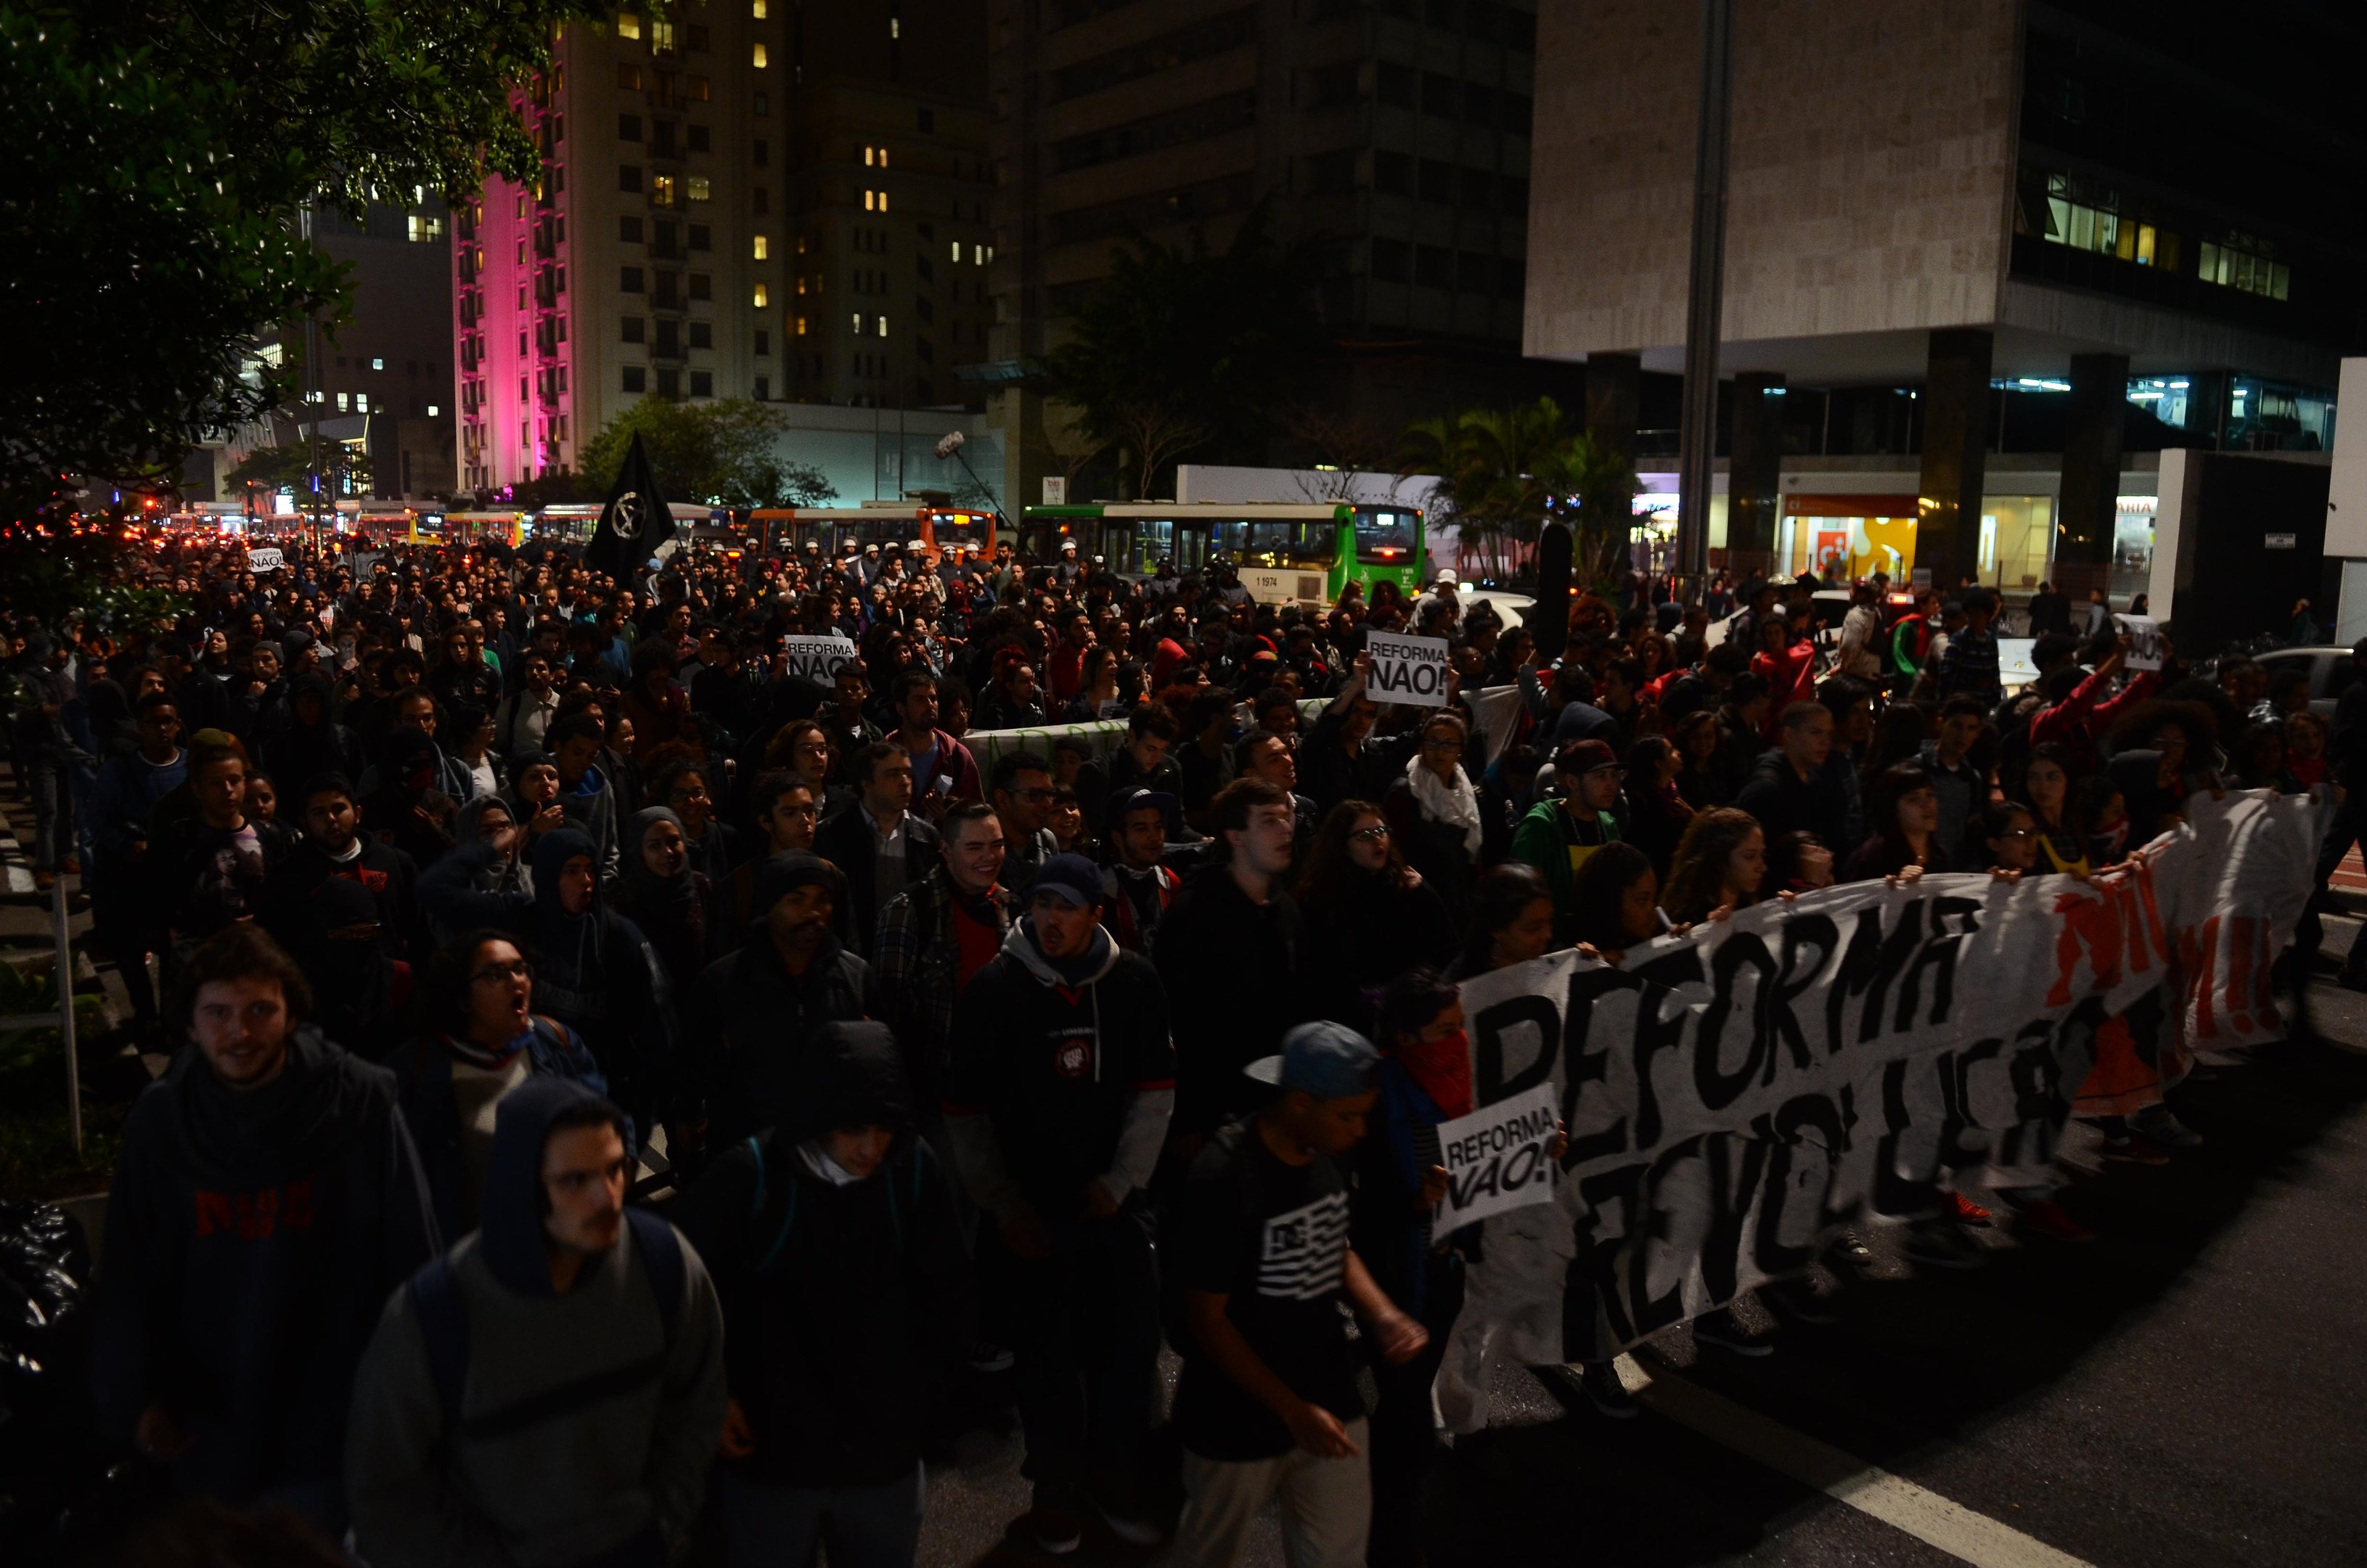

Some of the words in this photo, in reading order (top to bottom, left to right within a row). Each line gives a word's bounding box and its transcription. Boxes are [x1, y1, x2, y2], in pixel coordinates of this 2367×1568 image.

[788, 642, 854, 656] REFORMA
[1370, 641, 1446, 663] REFORMA
[1368, 658, 1447, 696] NÃO!
[1447, 1106, 1555, 1169] REFORMA
